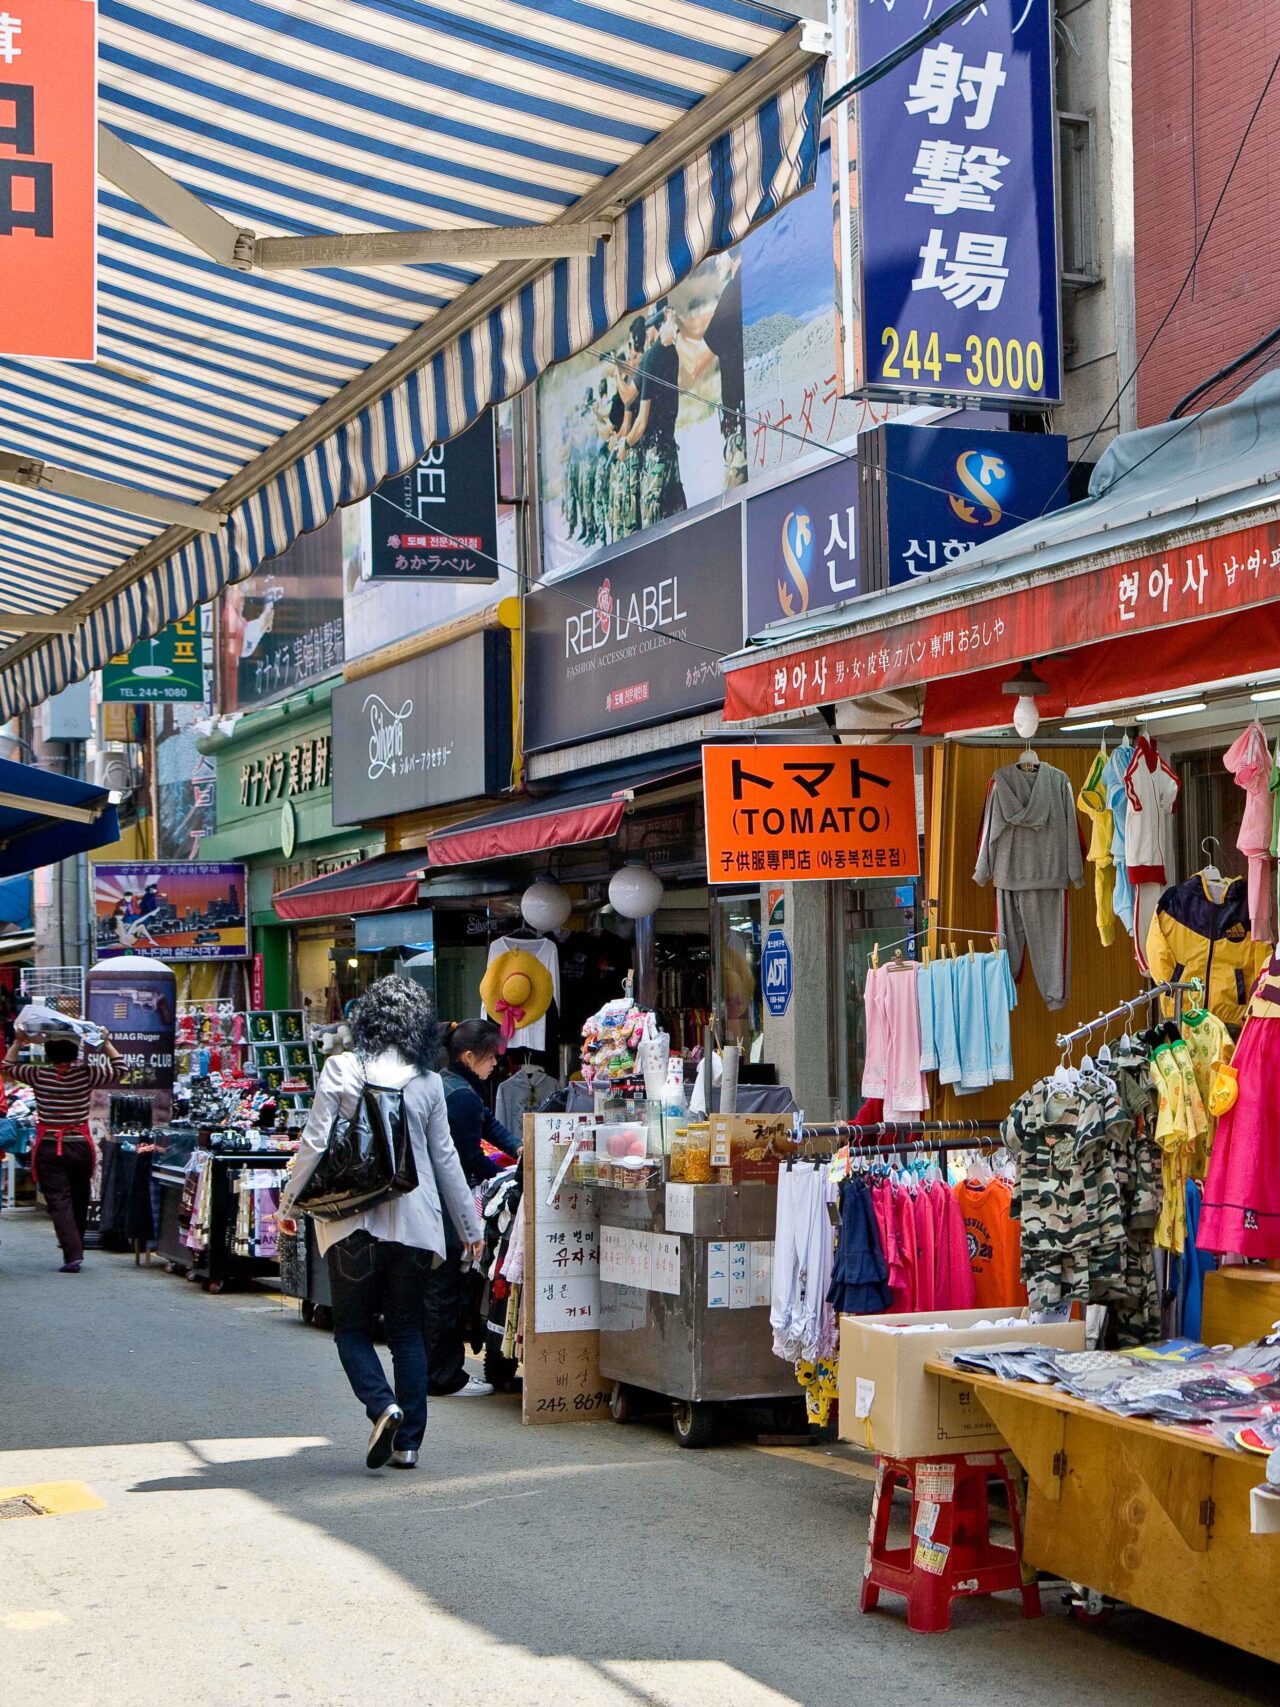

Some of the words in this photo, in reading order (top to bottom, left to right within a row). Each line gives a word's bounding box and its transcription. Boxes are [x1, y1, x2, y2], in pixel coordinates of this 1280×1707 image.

[881, 326, 1044, 392] 244-3000
[395, 554, 477, 572] あかラベル
[565, 607, 611, 659] RED
[616, 576, 688, 642] LABEL
[566, 660, 596, 680] FASHION
[598, 644, 638, 671] ACCESSORY
[638, 627, 688, 658] COLLECTION
[139, 687, 188, 697] 244-1080
[731, 758, 892, 801] トマト
[732, 805, 891, 836] (TOMATO)
[767, 957, 788, 987] ADT
[114, 1032, 136, 1041] MAG
[137, 1032, 161, 1042] Ruger
[87, 1053, 145, 1068] SHOING
[150, 1053, 173, 1068] CLUB
